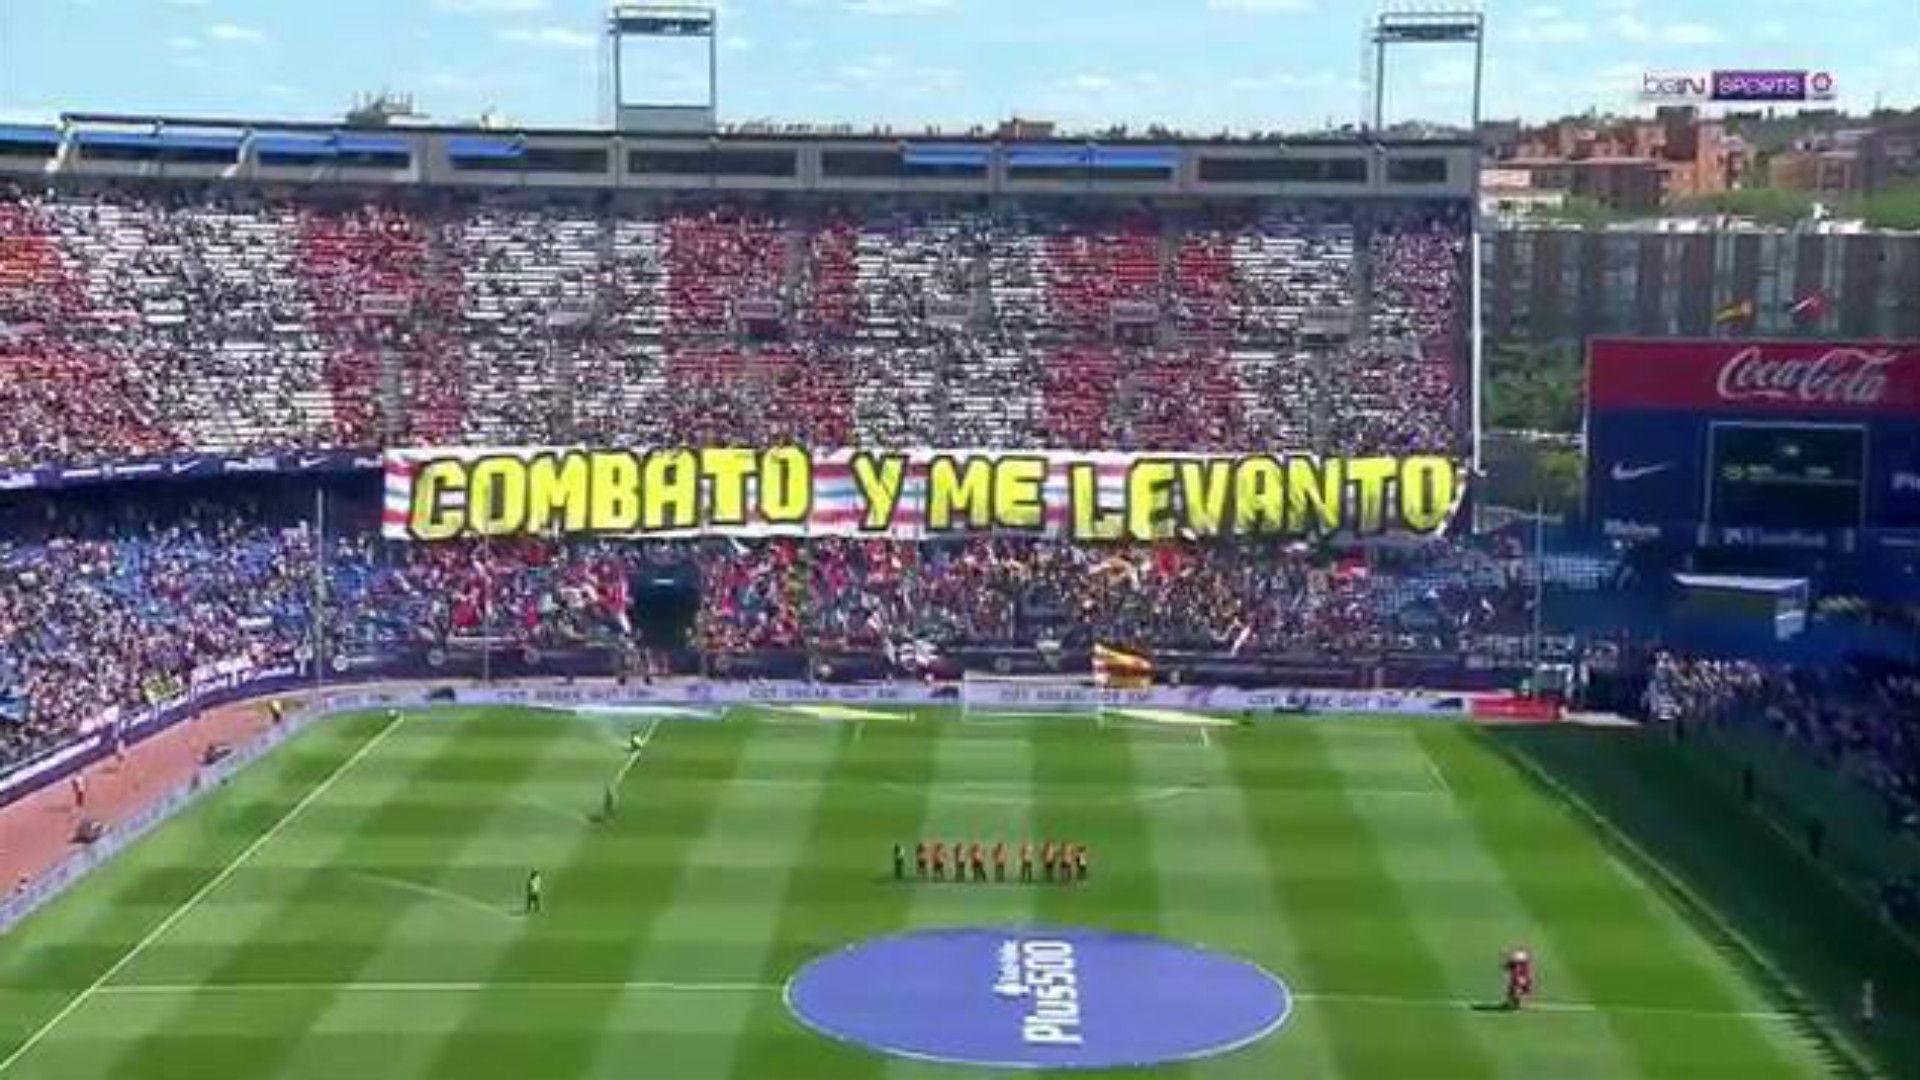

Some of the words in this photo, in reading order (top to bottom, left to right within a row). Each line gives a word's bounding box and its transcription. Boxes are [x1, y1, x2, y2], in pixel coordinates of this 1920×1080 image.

[407, 446, 813, 541] COMBATO
[850, 452, 904, 531] Y
[925, 454, 1050, 530] ME
[1068, 454, 1457, 541] LEVANTO
[1023, 940, 1083, 1045] Plus500
